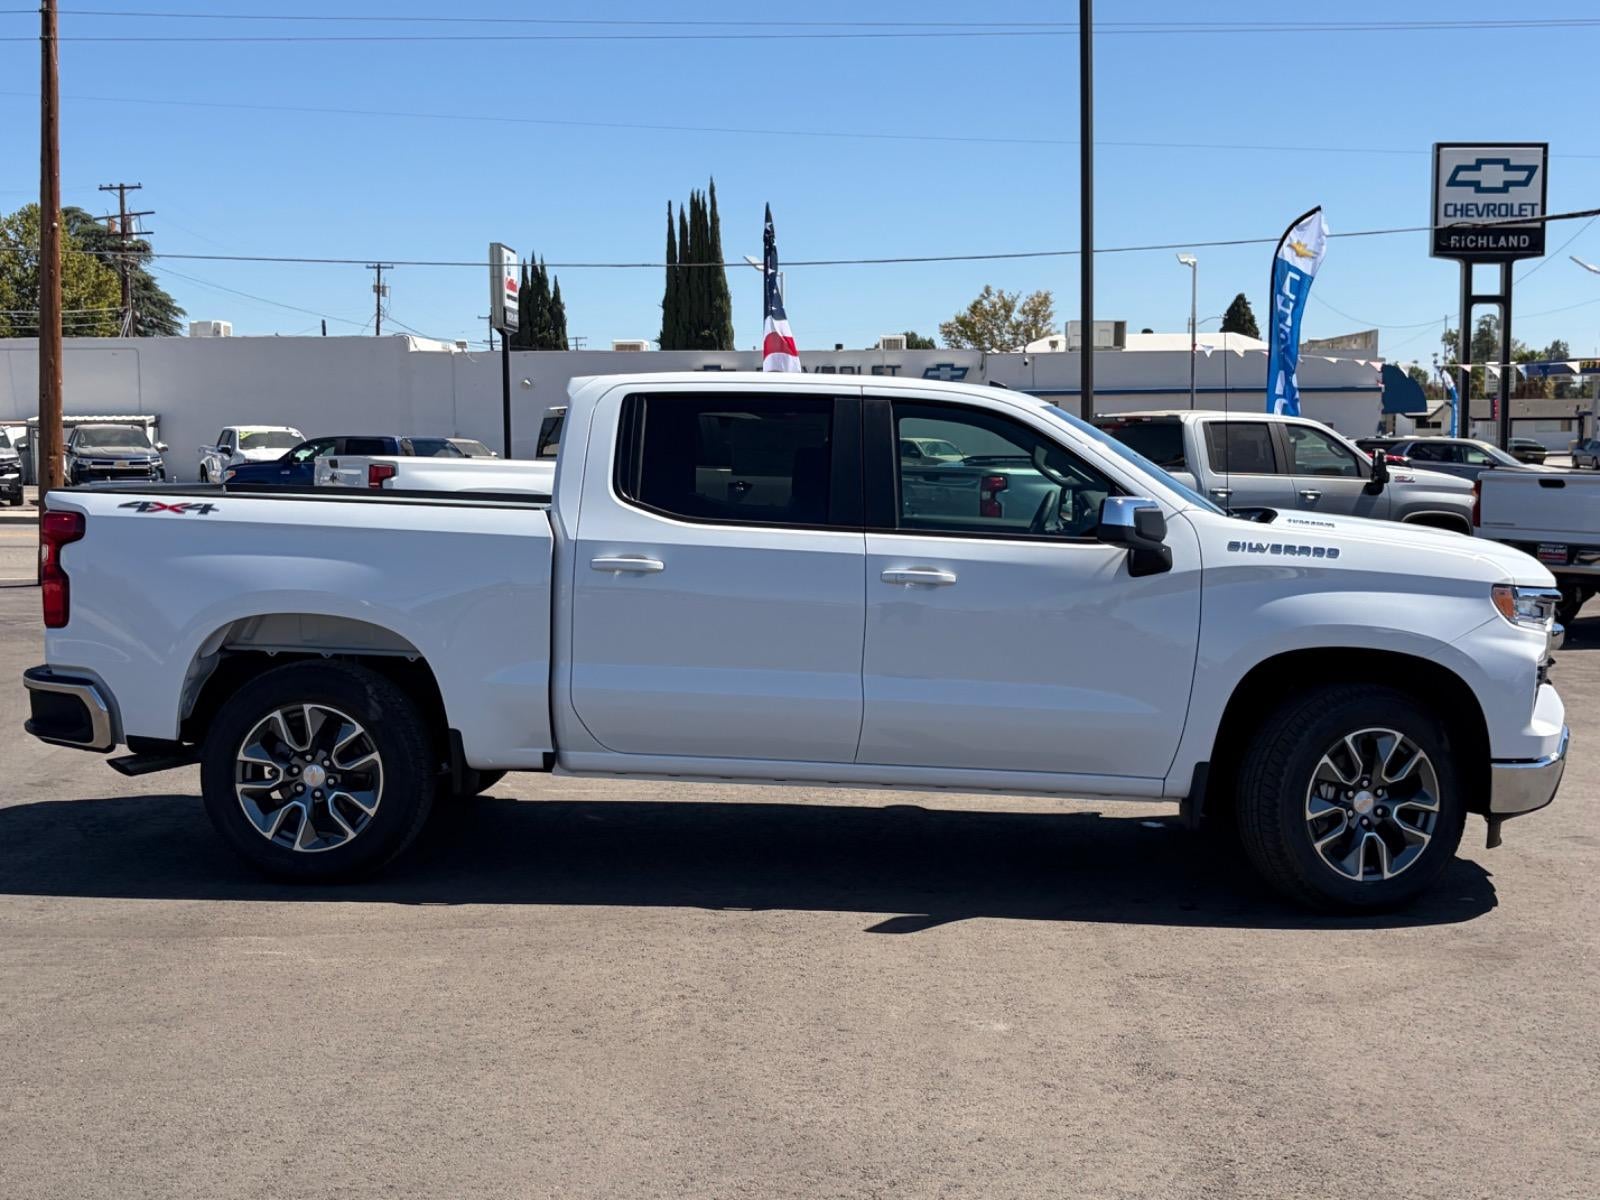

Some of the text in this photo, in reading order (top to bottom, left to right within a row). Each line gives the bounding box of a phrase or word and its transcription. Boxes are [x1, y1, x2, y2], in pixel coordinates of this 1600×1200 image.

[1444, 203, 1539, 218] CHEVROLET
[1450, 235, 1530, 248] RICHLAND
[1226, 541, 1340, 559] SILVERADO
